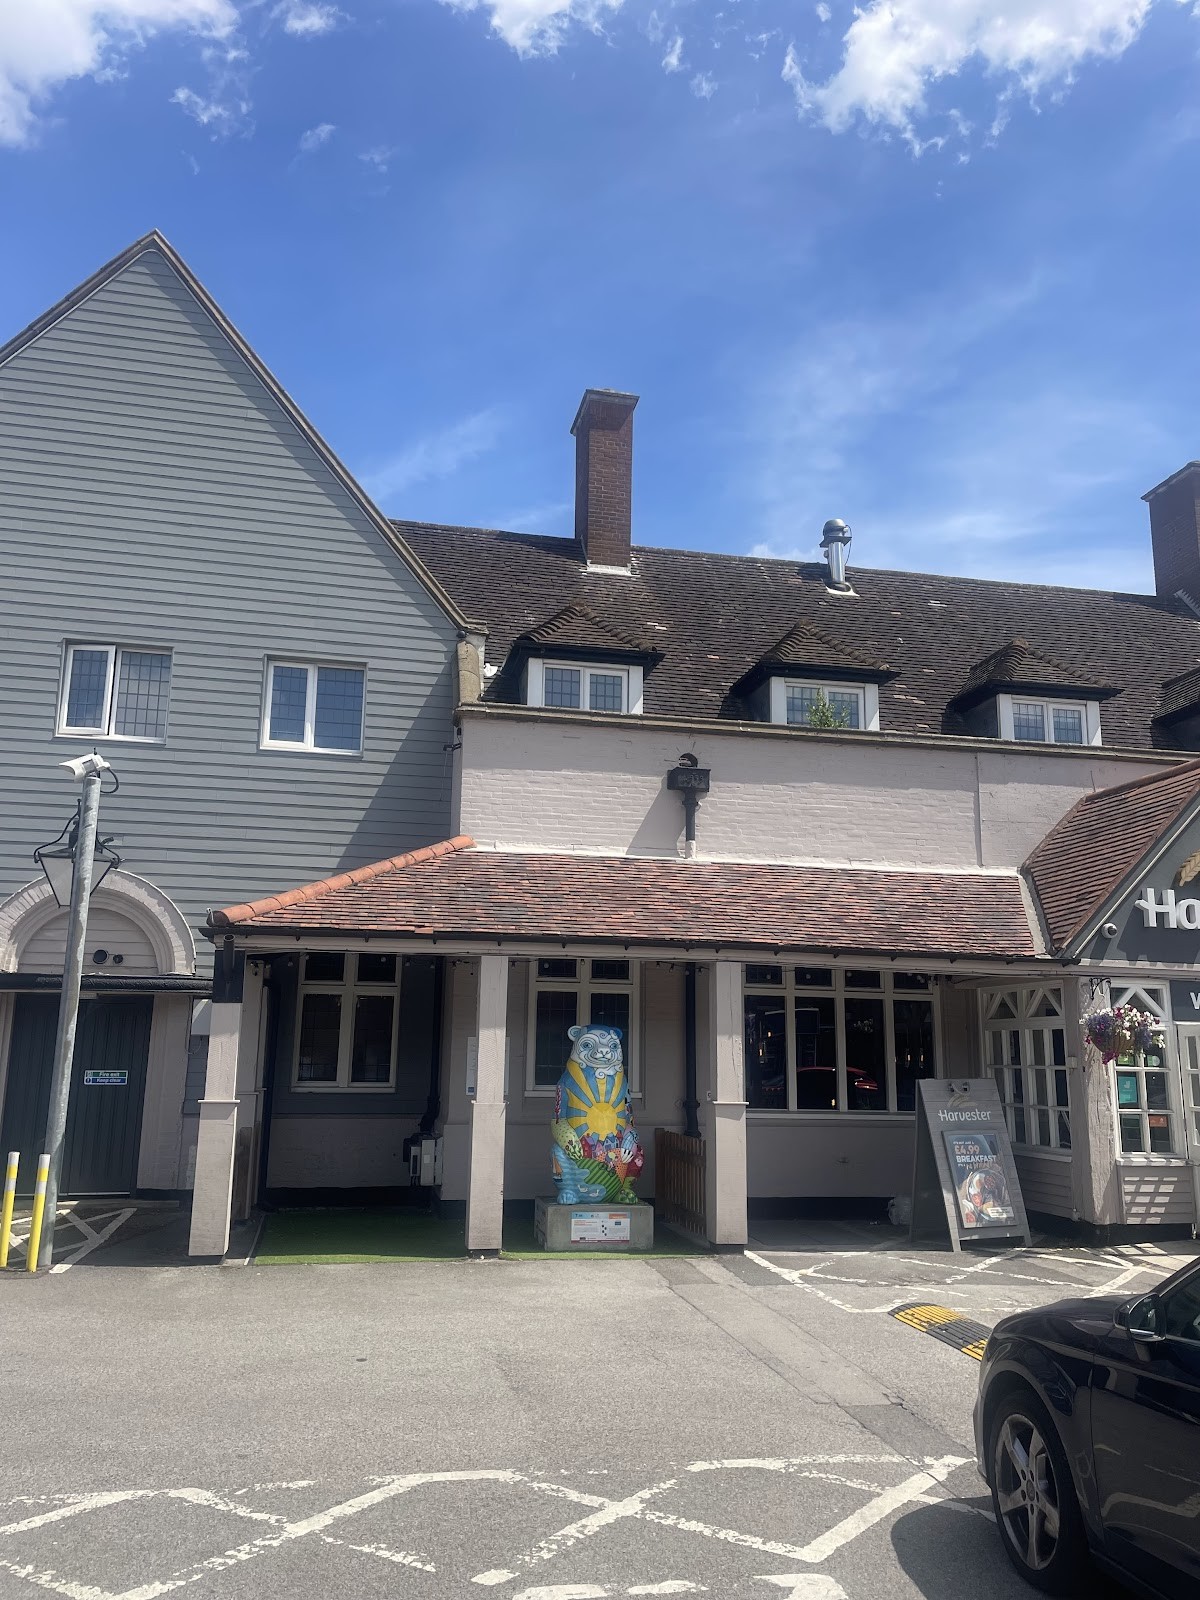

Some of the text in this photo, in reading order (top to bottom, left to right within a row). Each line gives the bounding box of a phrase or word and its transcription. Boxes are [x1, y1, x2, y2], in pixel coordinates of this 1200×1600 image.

[938, 1108, 991, 1121] Harvester
[954, 1145, 980, 1154] £4.99
[956, 1155, 997, 1163] BREAKFAST
